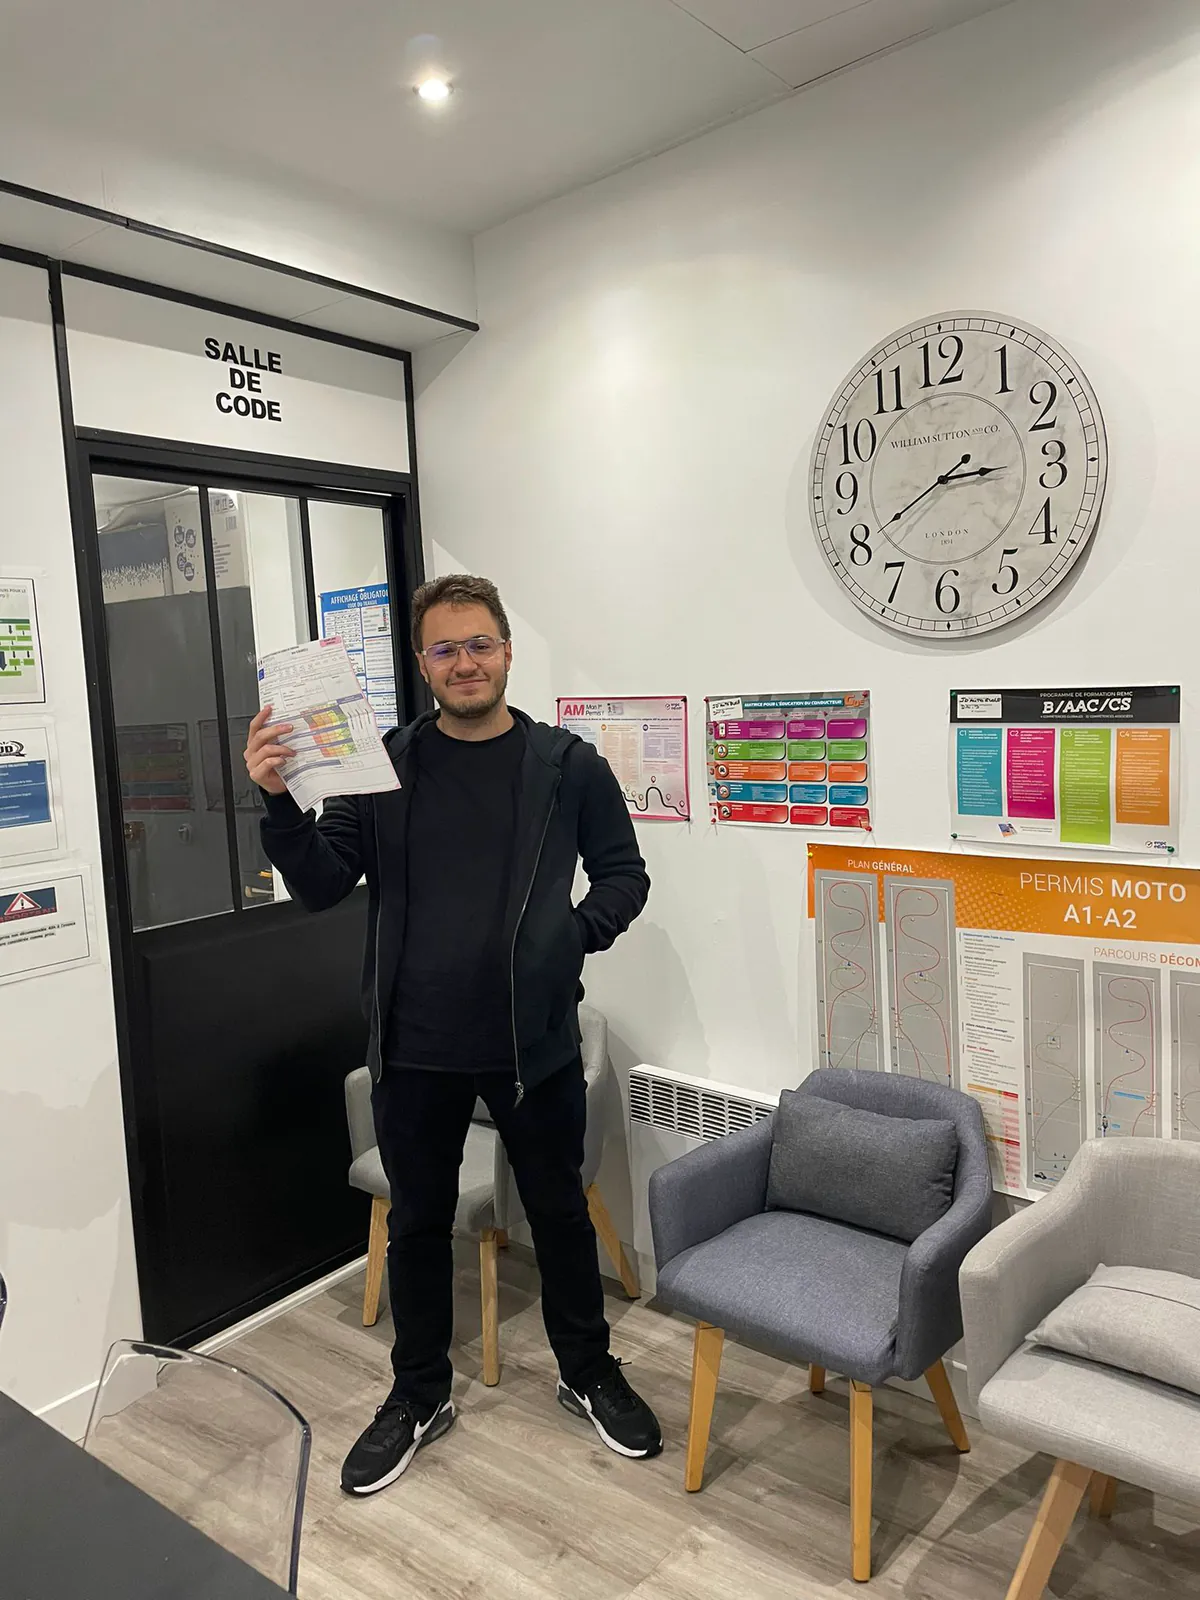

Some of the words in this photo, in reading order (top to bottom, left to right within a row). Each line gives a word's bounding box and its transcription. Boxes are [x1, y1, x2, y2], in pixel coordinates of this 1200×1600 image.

[204, 337, 283, 374] SALLE
[918, 335, 964, 389] 12
[994, 344, 1014, 395] 1
[229, 368, 262, 393] DE
[872, 365, 907, 416] 11
[215, 392, 282, 422] CODE
[1028, 380, 1058, 432] 2
[838, 418, 877, 466] 10
[891, 436, 931, 449] WILLIAM
[932, 429, 970, 443] SUTTON
[984, 424, 1001, 434] CO.
[1039, 440, 1068, 489] 3
[835, 471, 859, 515] 9
[925, 528, 969, 539] LONDON
[1028, 496, 1058, 545] 4
[850, 523, 873, 566] 8
[883, 561, 906, 604] 7
[991, 547, 1019, 595] 5
[331, 593, 359, 605] AFFICHAGE
[935, 569, 960, 614] 6
[563, 704, 585, 716] AM
[1042, 697, 1132, 714] B/AAC/CS
[1119, 730, 1130, 738] C4
[847, 859, 870, 870] PLAN
[872, 859, 915, 874] GÉNÉRAL
[1020, 872, 1103, 897] PERMIS
[1111, 879, 1187, 903] MOTO
[1063, 903, 1137, 929] A1-A2
[1094, 947, 1157, 963] PARCOURS
[1160, 953, 1200, 968] DÉCON
